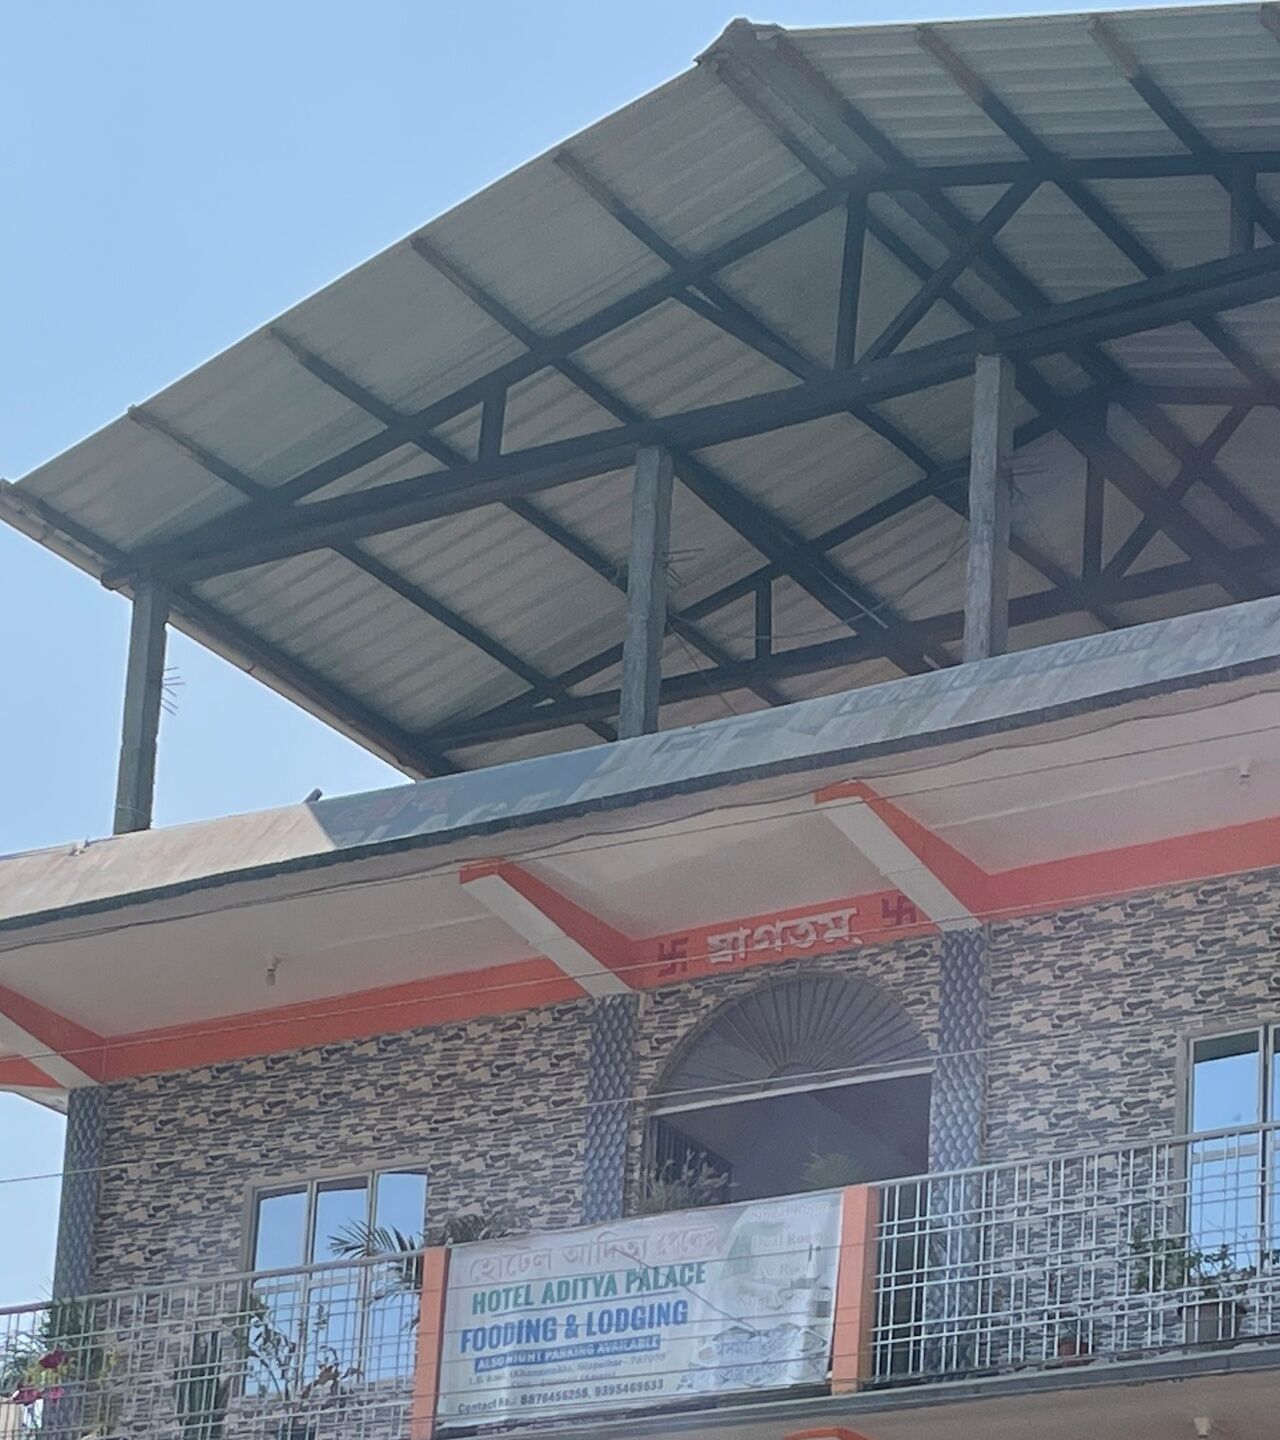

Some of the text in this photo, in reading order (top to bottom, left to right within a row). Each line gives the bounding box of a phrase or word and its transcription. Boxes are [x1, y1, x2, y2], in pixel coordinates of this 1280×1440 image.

[472, 1262, 707, 1317] HOTEL ADITYA PALACE
[460, 1299, 690, 1355] FOODING & LODGING
[477, 1357, 505, 1370] ALSO
[545, 1344, 596, 1361] PARKING
[597, 1336, 660, 1354] AVAILABLE
